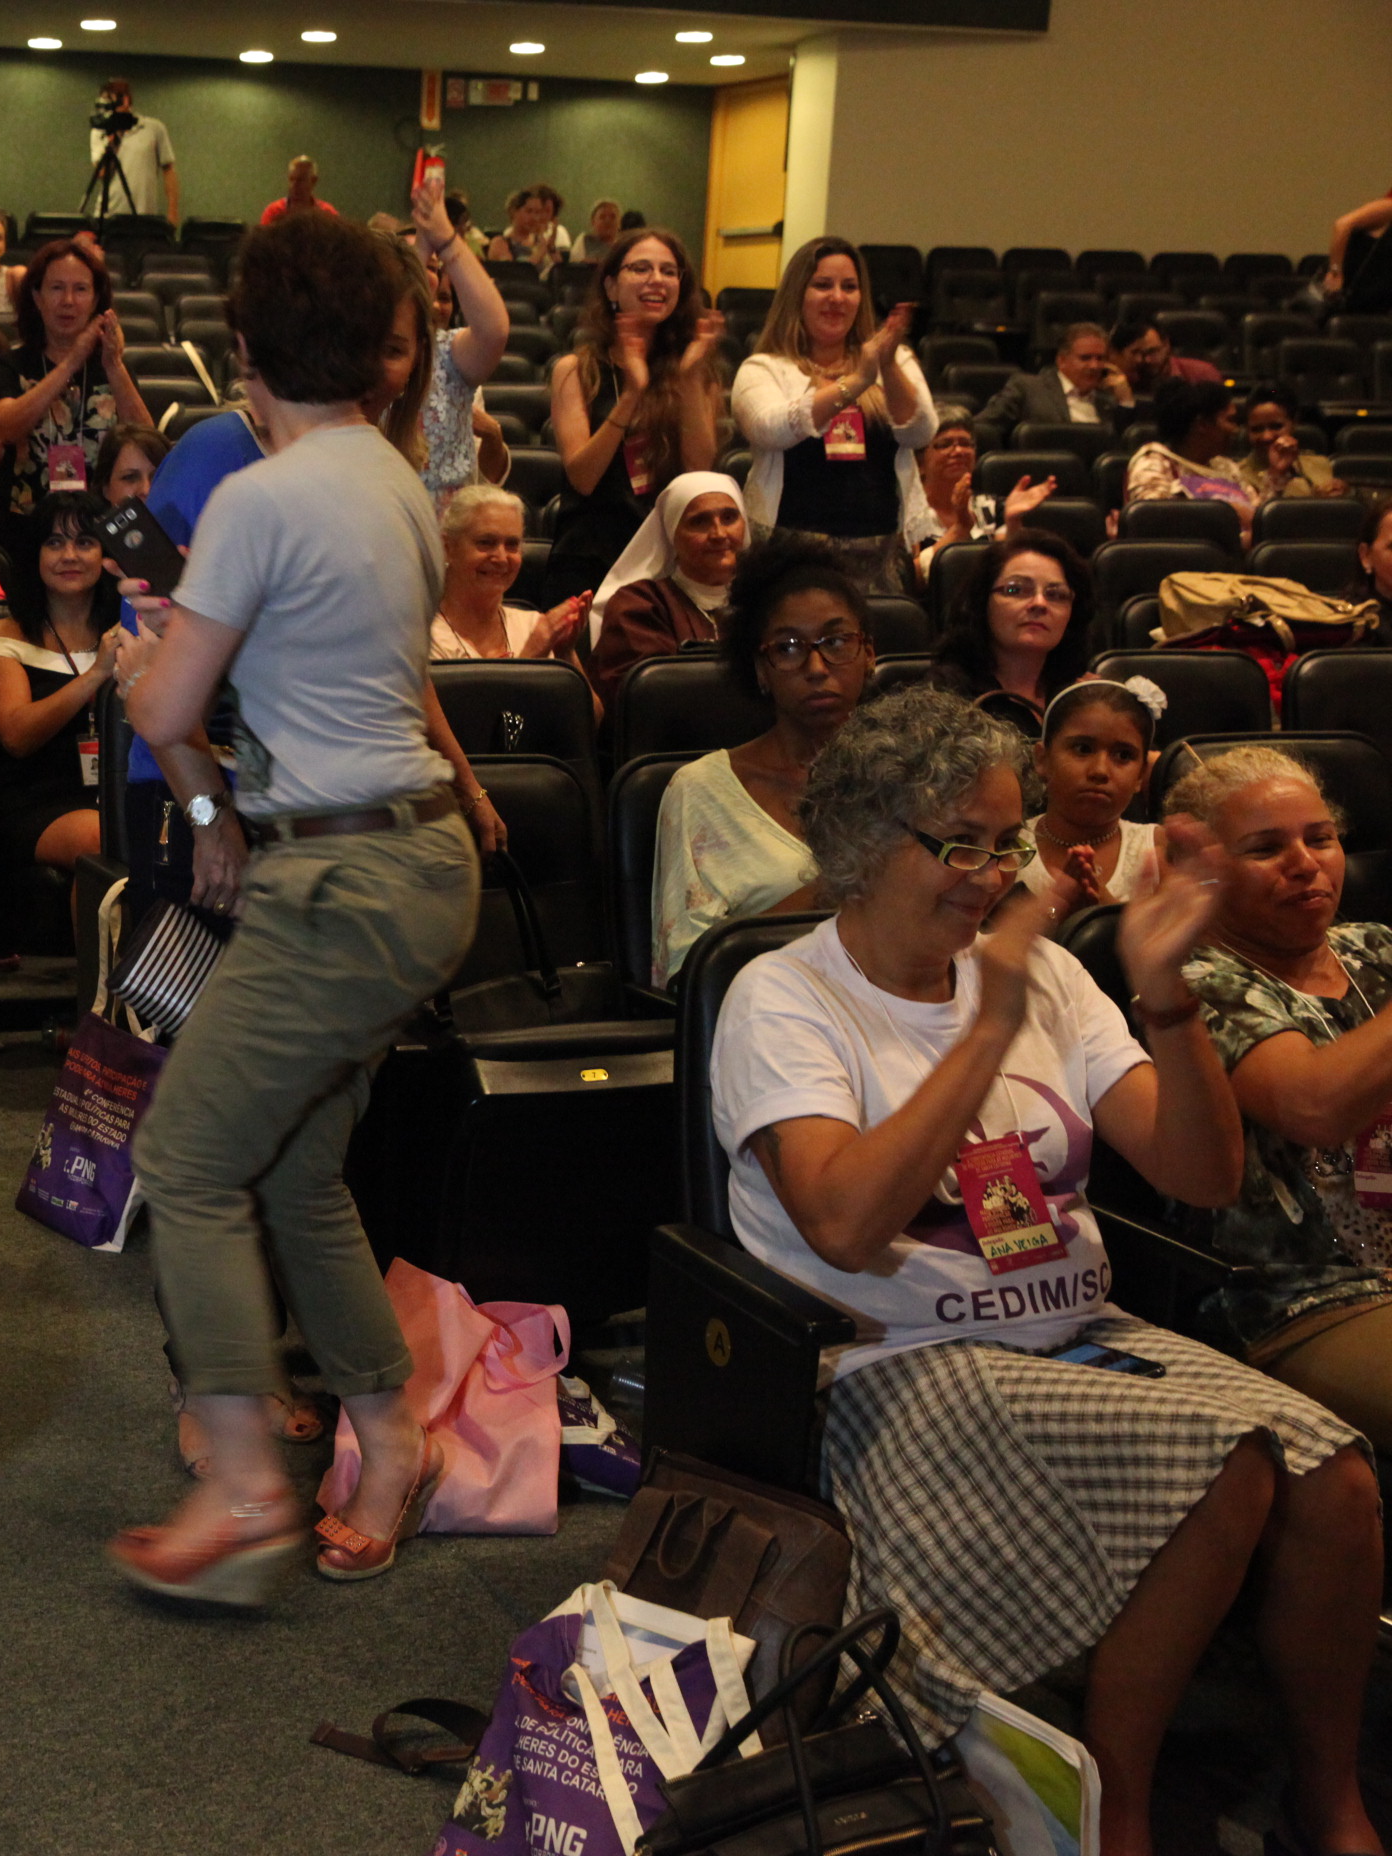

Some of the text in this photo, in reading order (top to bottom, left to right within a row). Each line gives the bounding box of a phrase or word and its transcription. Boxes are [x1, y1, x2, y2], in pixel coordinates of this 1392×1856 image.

[97, 1122, 127, 1143] ESTADO
[990, 1243, 1016, 1258] ANA
[713, 1331, 726, 1357] A
[557, 1749, 580, 1768] DO
[521, 1756, 558, 1781] SANTA
[560, 1769, 606, 1801] CATAR
